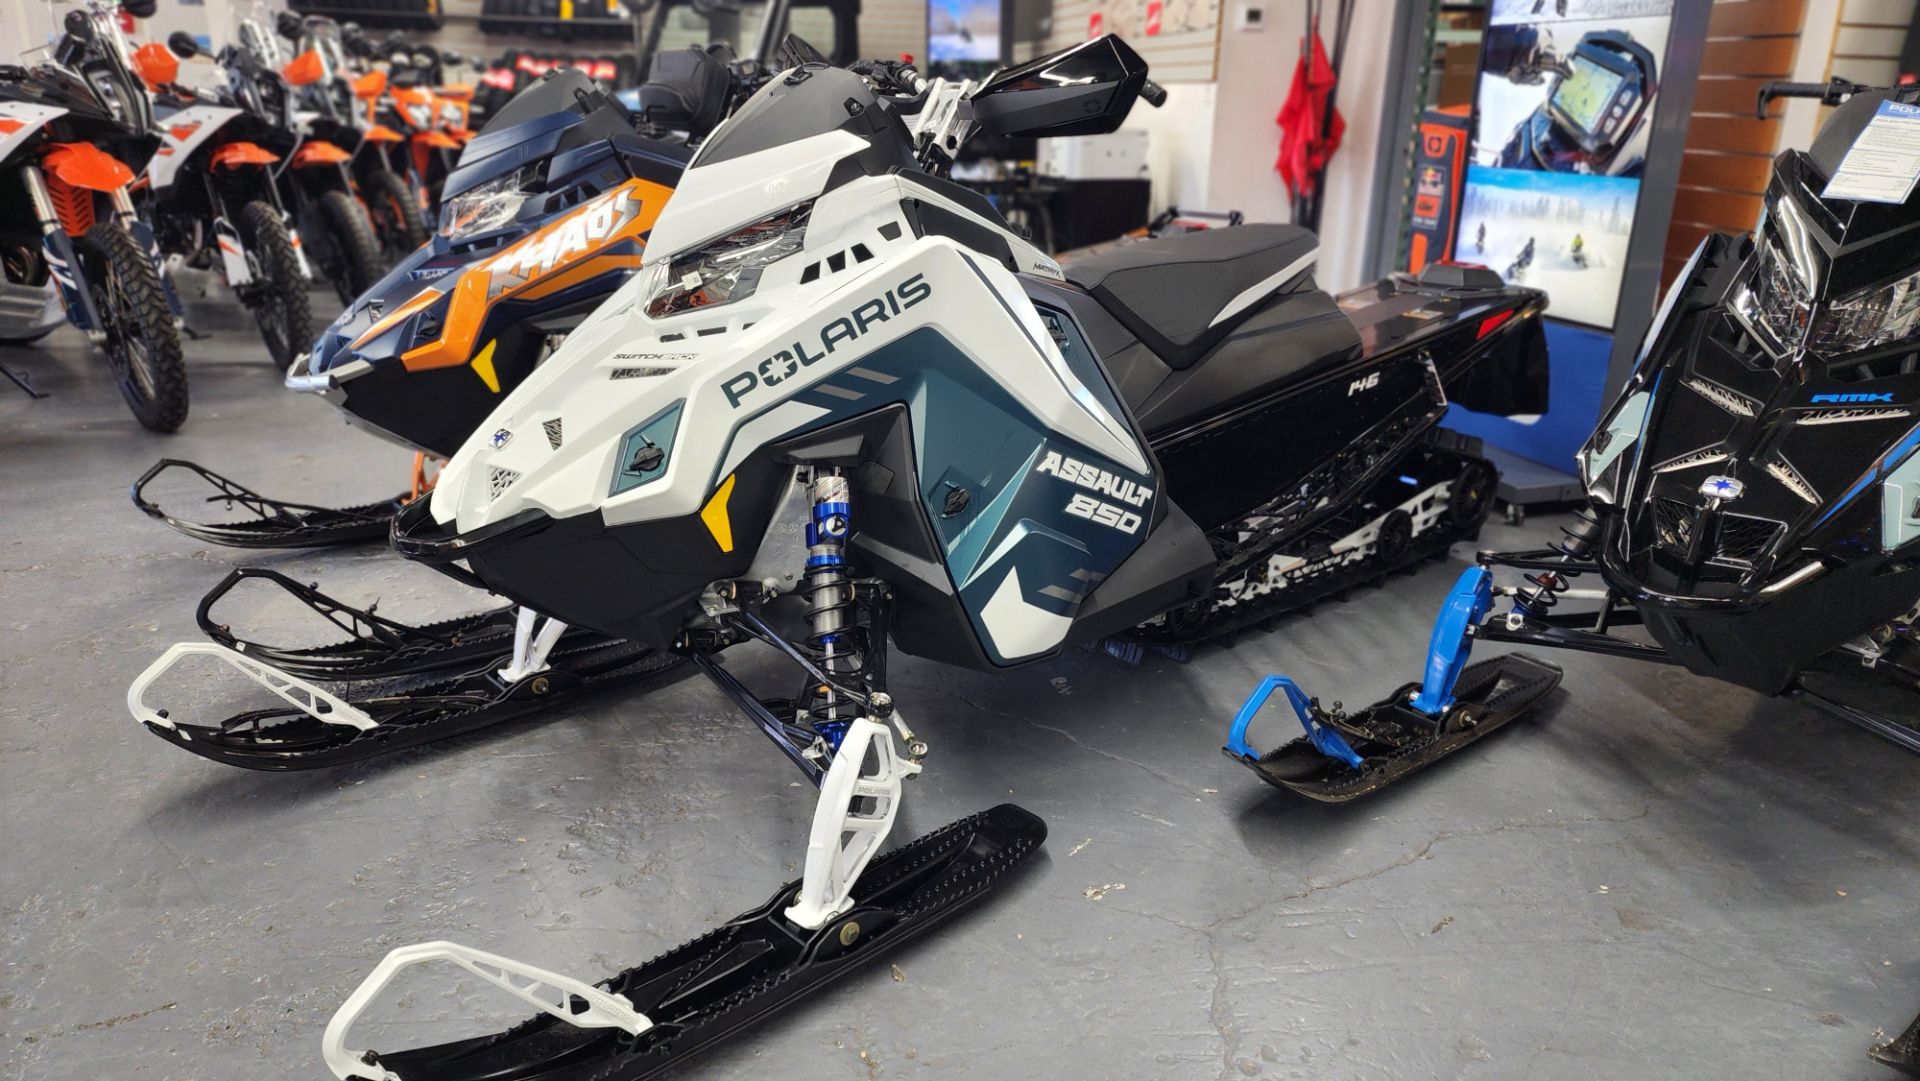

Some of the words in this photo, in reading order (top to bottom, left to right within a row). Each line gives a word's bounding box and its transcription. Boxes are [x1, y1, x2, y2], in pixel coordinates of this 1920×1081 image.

[720, 272, 932, 409] POLARIS
[1347, 371, 1381, 397] 146
[1811, 391, 1894, 403] RMK
[1036, 451, 1153, 507] ASSAULT
[1065, 493, 1142, 535] 850
